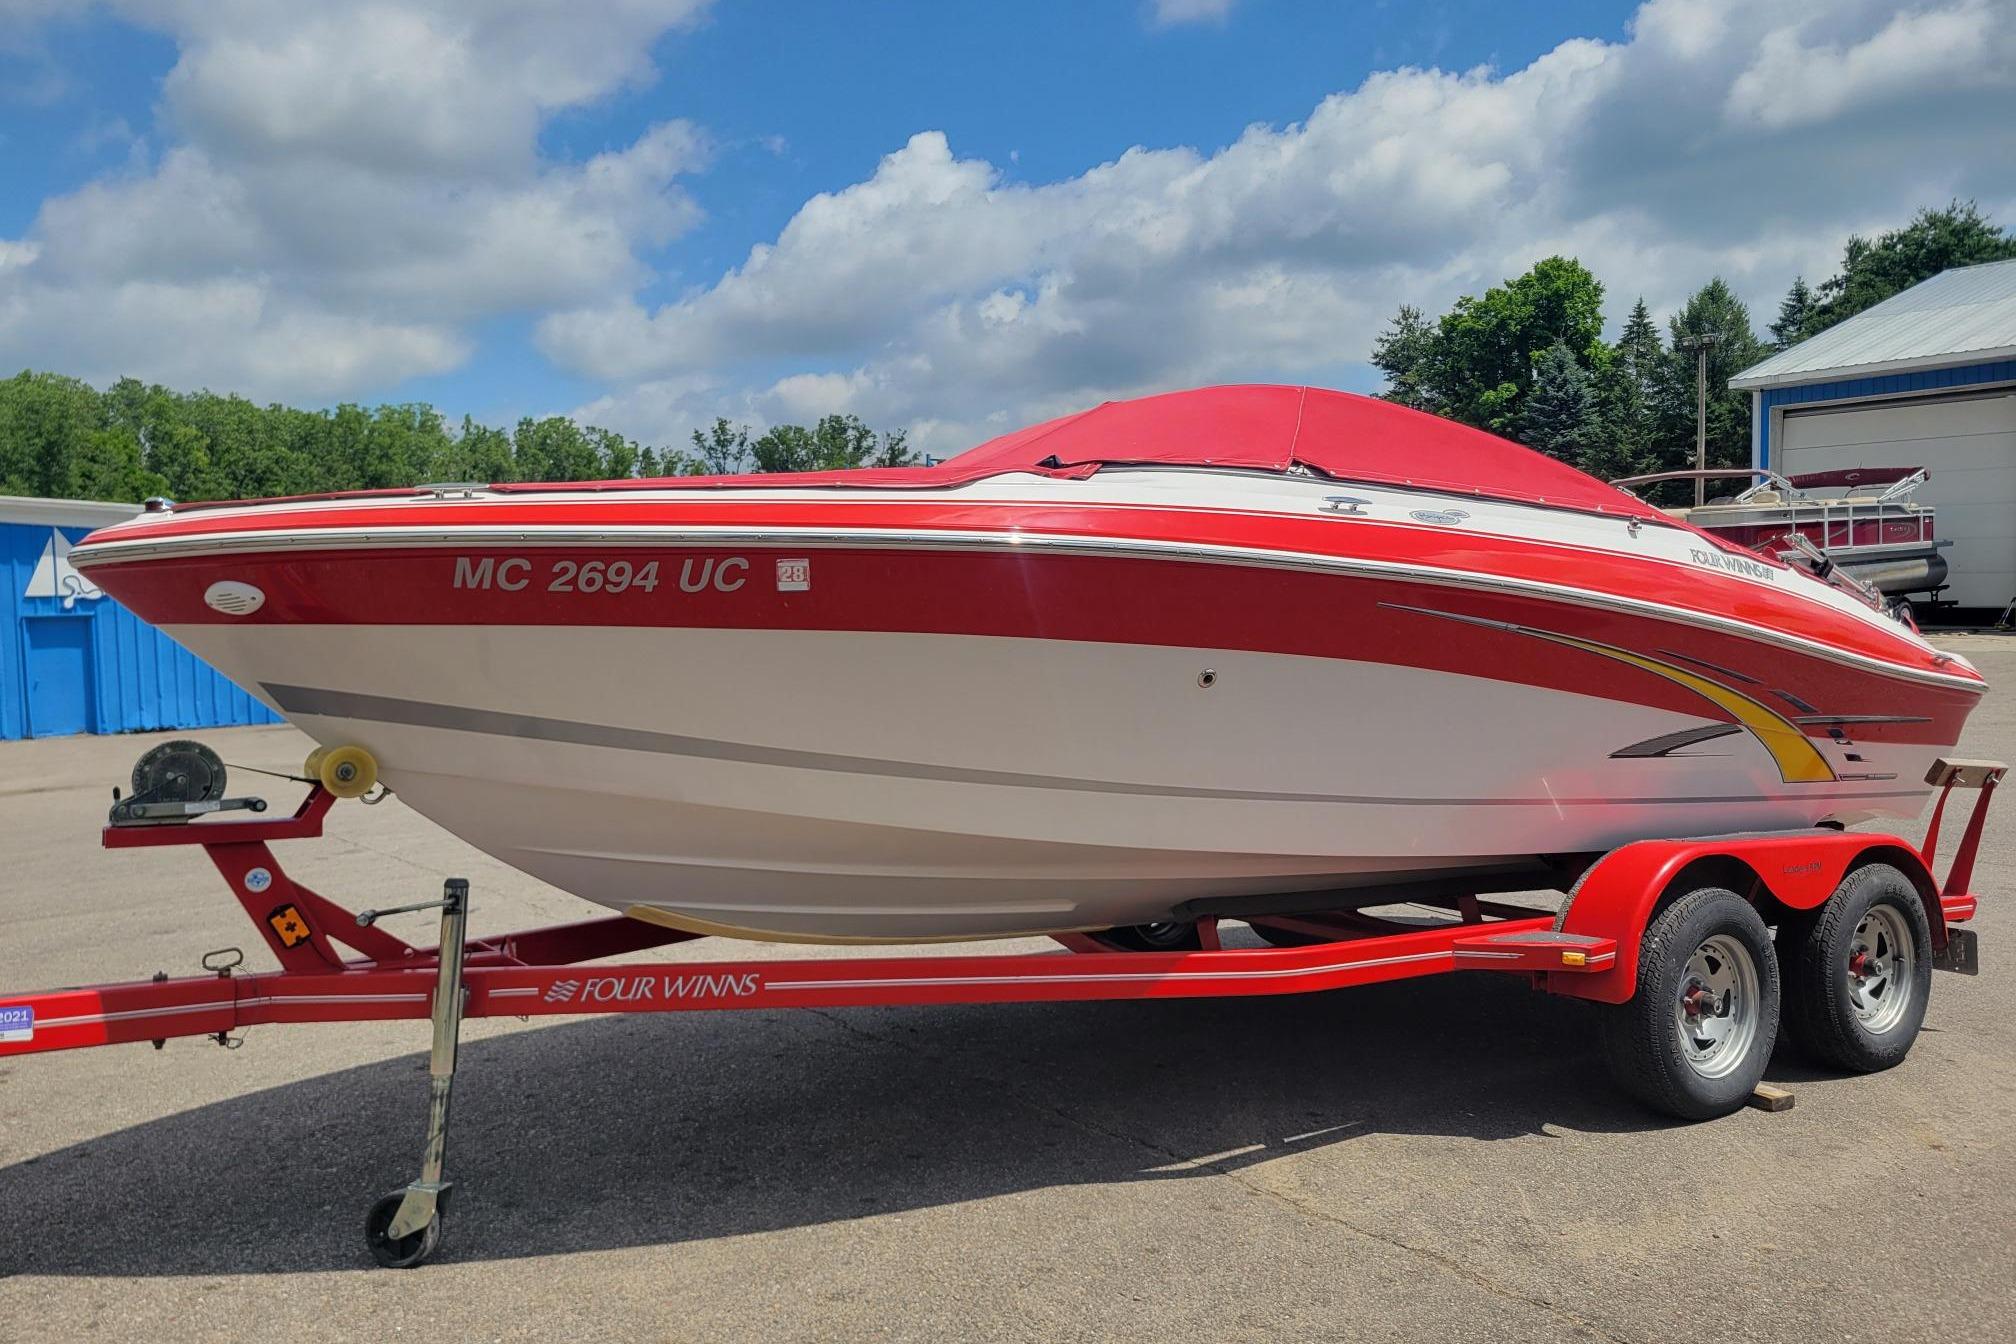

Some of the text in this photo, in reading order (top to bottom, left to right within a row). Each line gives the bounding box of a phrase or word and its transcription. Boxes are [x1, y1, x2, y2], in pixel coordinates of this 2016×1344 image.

[453, 557, 749, 593] MC 2694 UC
[779, 566, 805, 582] 28
[1689, 548, 1763, 579] FOUR WINNS
[580, 973, 760, 1002] FOUR WINNS
